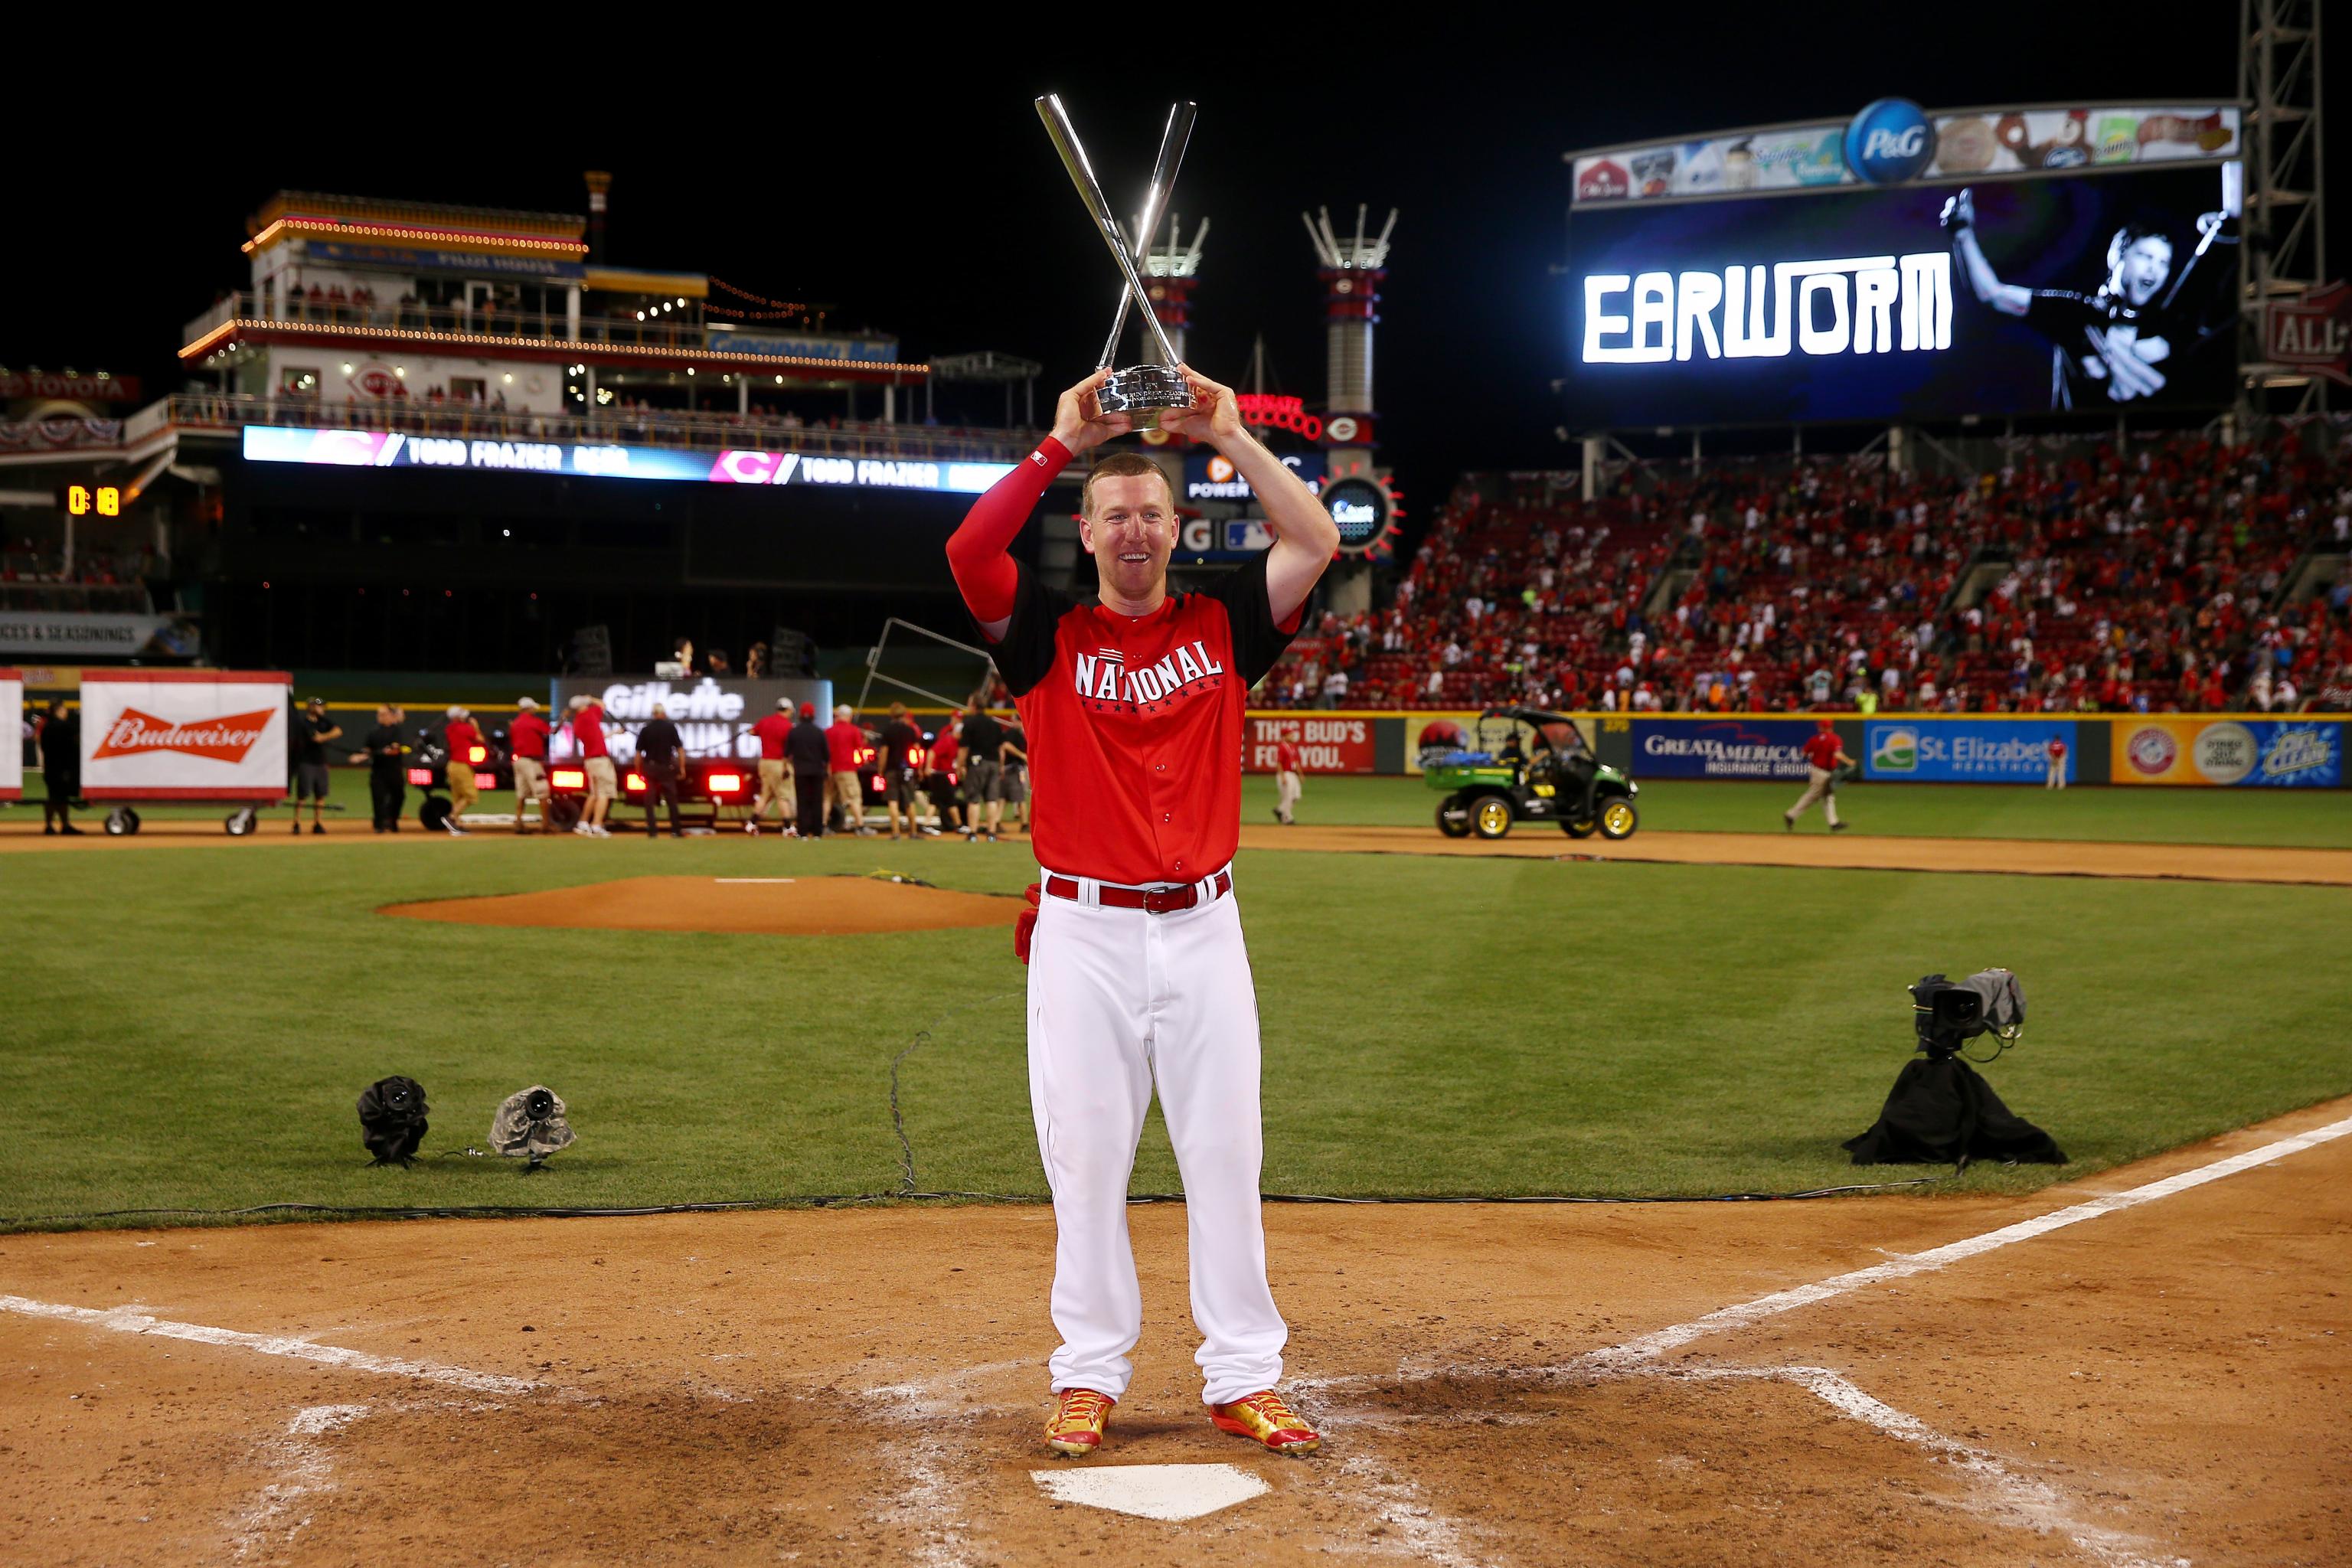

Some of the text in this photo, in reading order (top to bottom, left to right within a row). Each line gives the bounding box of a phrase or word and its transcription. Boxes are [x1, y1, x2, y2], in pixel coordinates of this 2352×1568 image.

[1863, 125, 1926, 160] P&G
[1582, 252, 1954, 364] EARWORM
[31, 376, 126, 398] TOYOTA
[406, 436, 468, 466] TODD
[470, 440, 563, 472] FRAZIER
[801, 456, 855, 484] TODD
[857, 459, 940, 488] FRAZIER
[1188, 482, 1250, 498] POWER
[46, 624, 136, 643] SEASONINGS
[1076, 641, 1225, 705] NATIONAL
[602, 676, 745, 721] Gillette
[107, 717, 263, 750] Budweiser
[1254, 720, 1367, 744] THS BUD'S
[1254, 745, 1279, 769] FO
[1298, 746, 1344, 769] YOU.
[1919, 735, 2051, 762] St. Elizabet
[1705, 762, 1771, 775] INSURANCE
